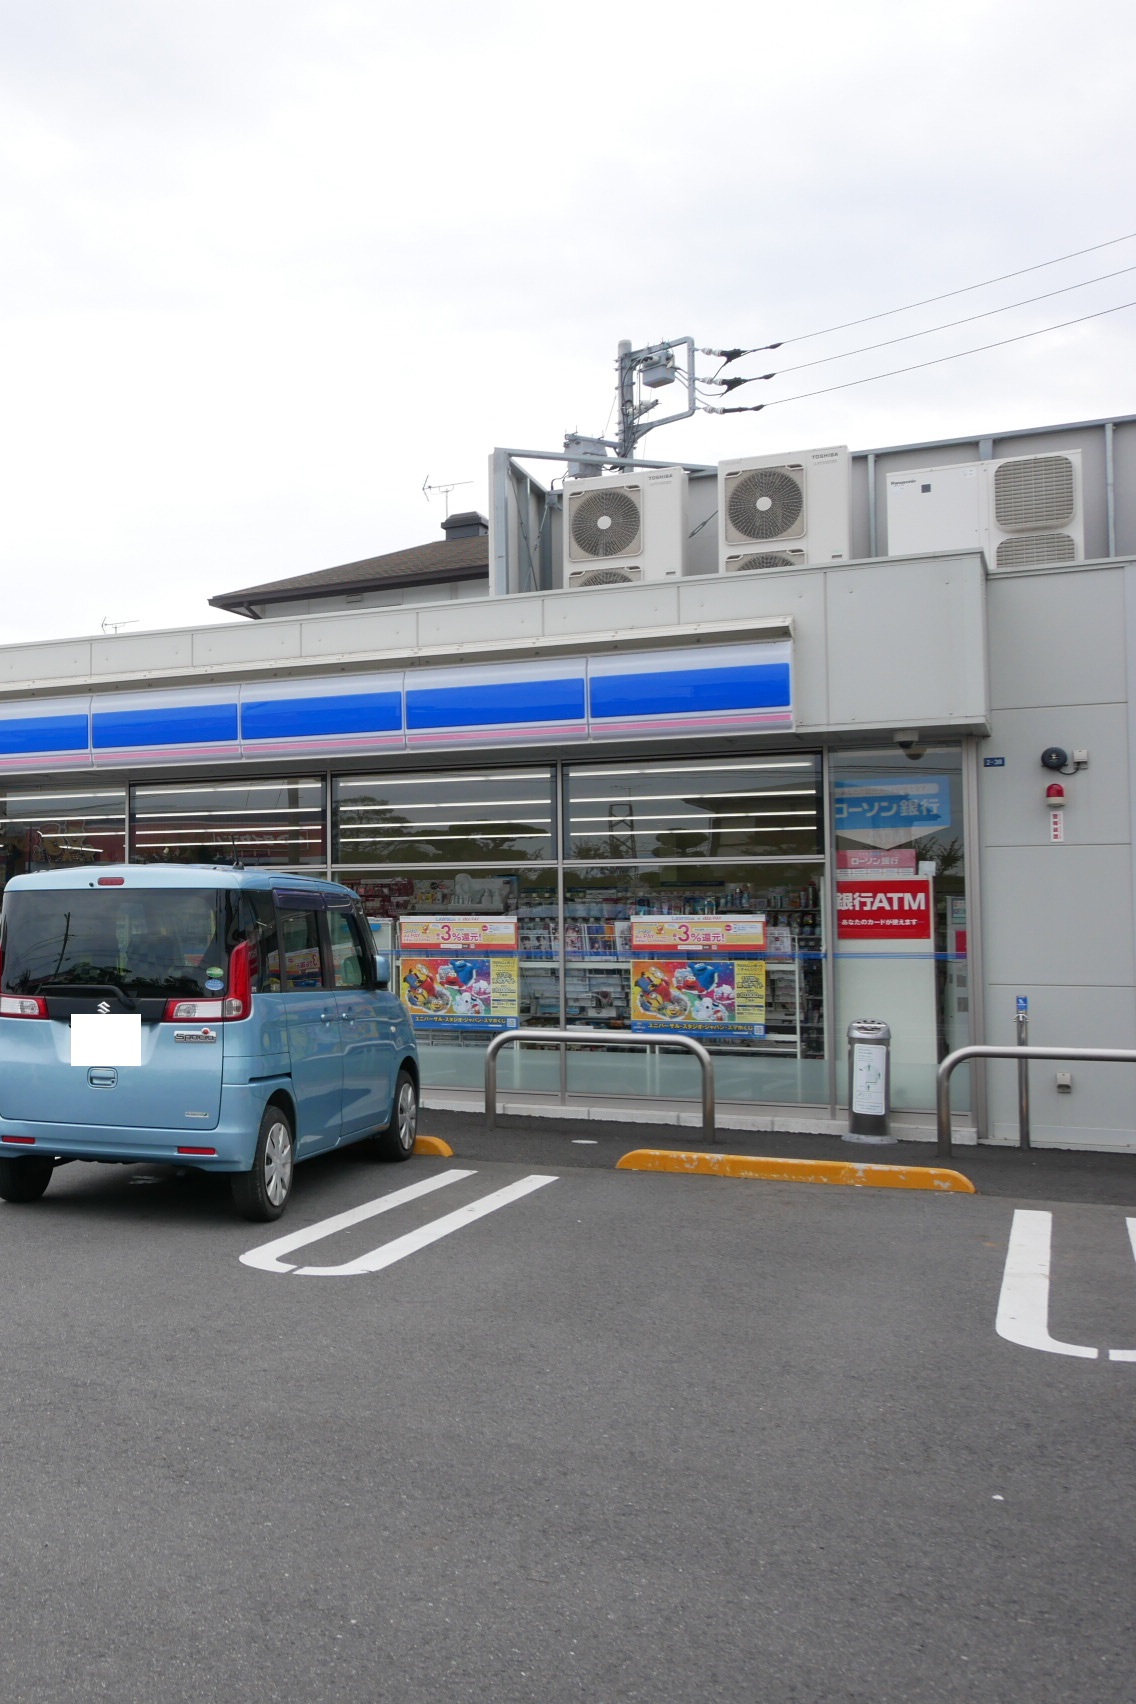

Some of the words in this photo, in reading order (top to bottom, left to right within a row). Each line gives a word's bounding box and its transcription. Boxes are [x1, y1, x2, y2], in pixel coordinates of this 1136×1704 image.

[811, 452, 839, 460] TOSHIBA
[648, 473, 673, 481] TOSHIBA
[835, 798, 941, 818] ローソン銀行
[851, 856, 900, 866] ローソン銀行
[836, 892, 926, 911] 銀行ATM
[841, 918, 918, 926] あなたのカードが使えます
